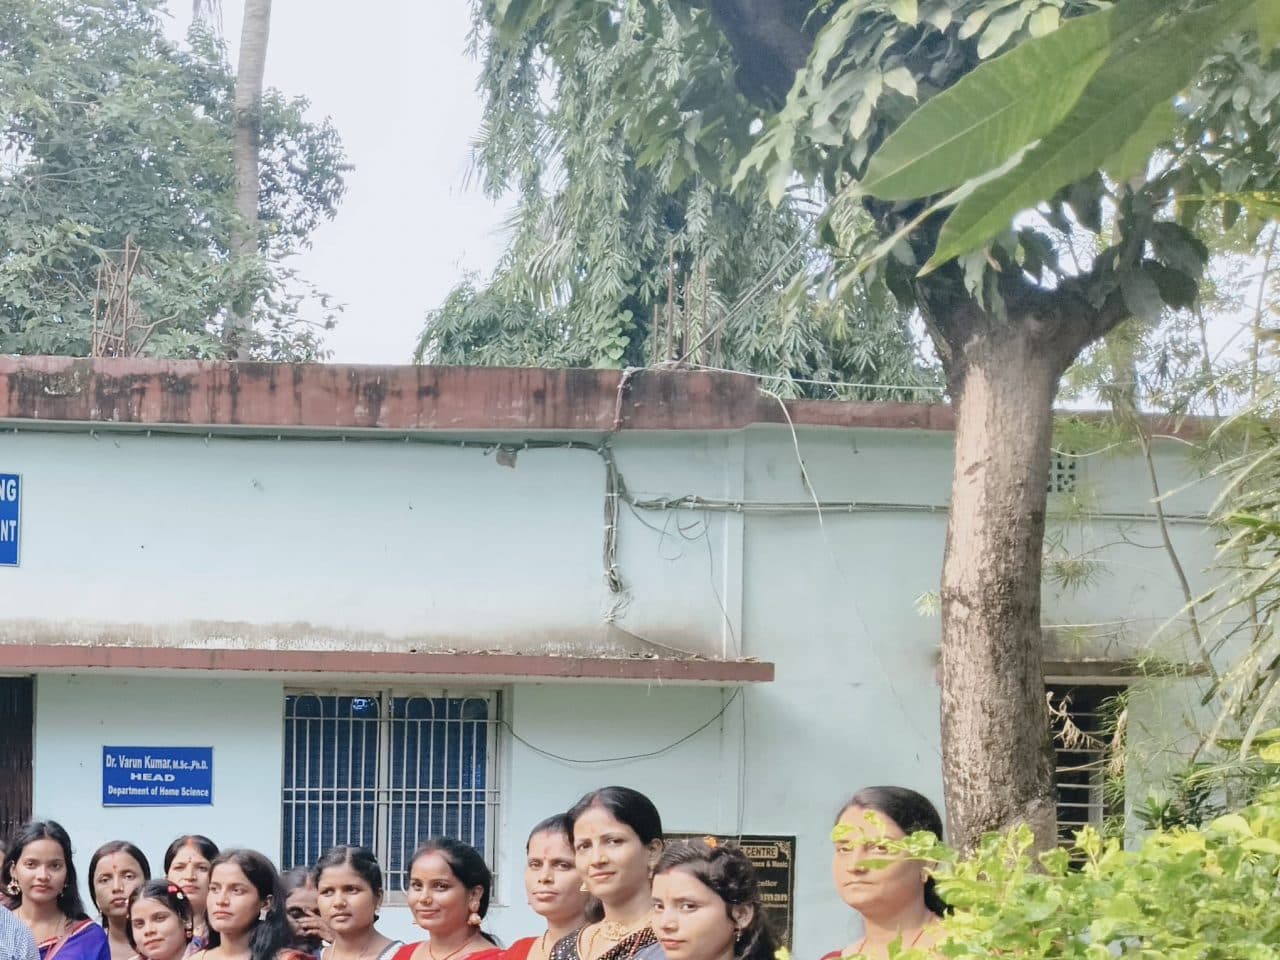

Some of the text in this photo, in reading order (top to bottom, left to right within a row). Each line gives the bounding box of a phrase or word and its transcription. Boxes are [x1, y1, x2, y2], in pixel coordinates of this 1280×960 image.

[106, 754, 117, 768] Dr.
[119, 754, 142, 768] Varun
[130, 772, 175, 782] HEAD
[108, 785, 209, 797] Department of Home Science
